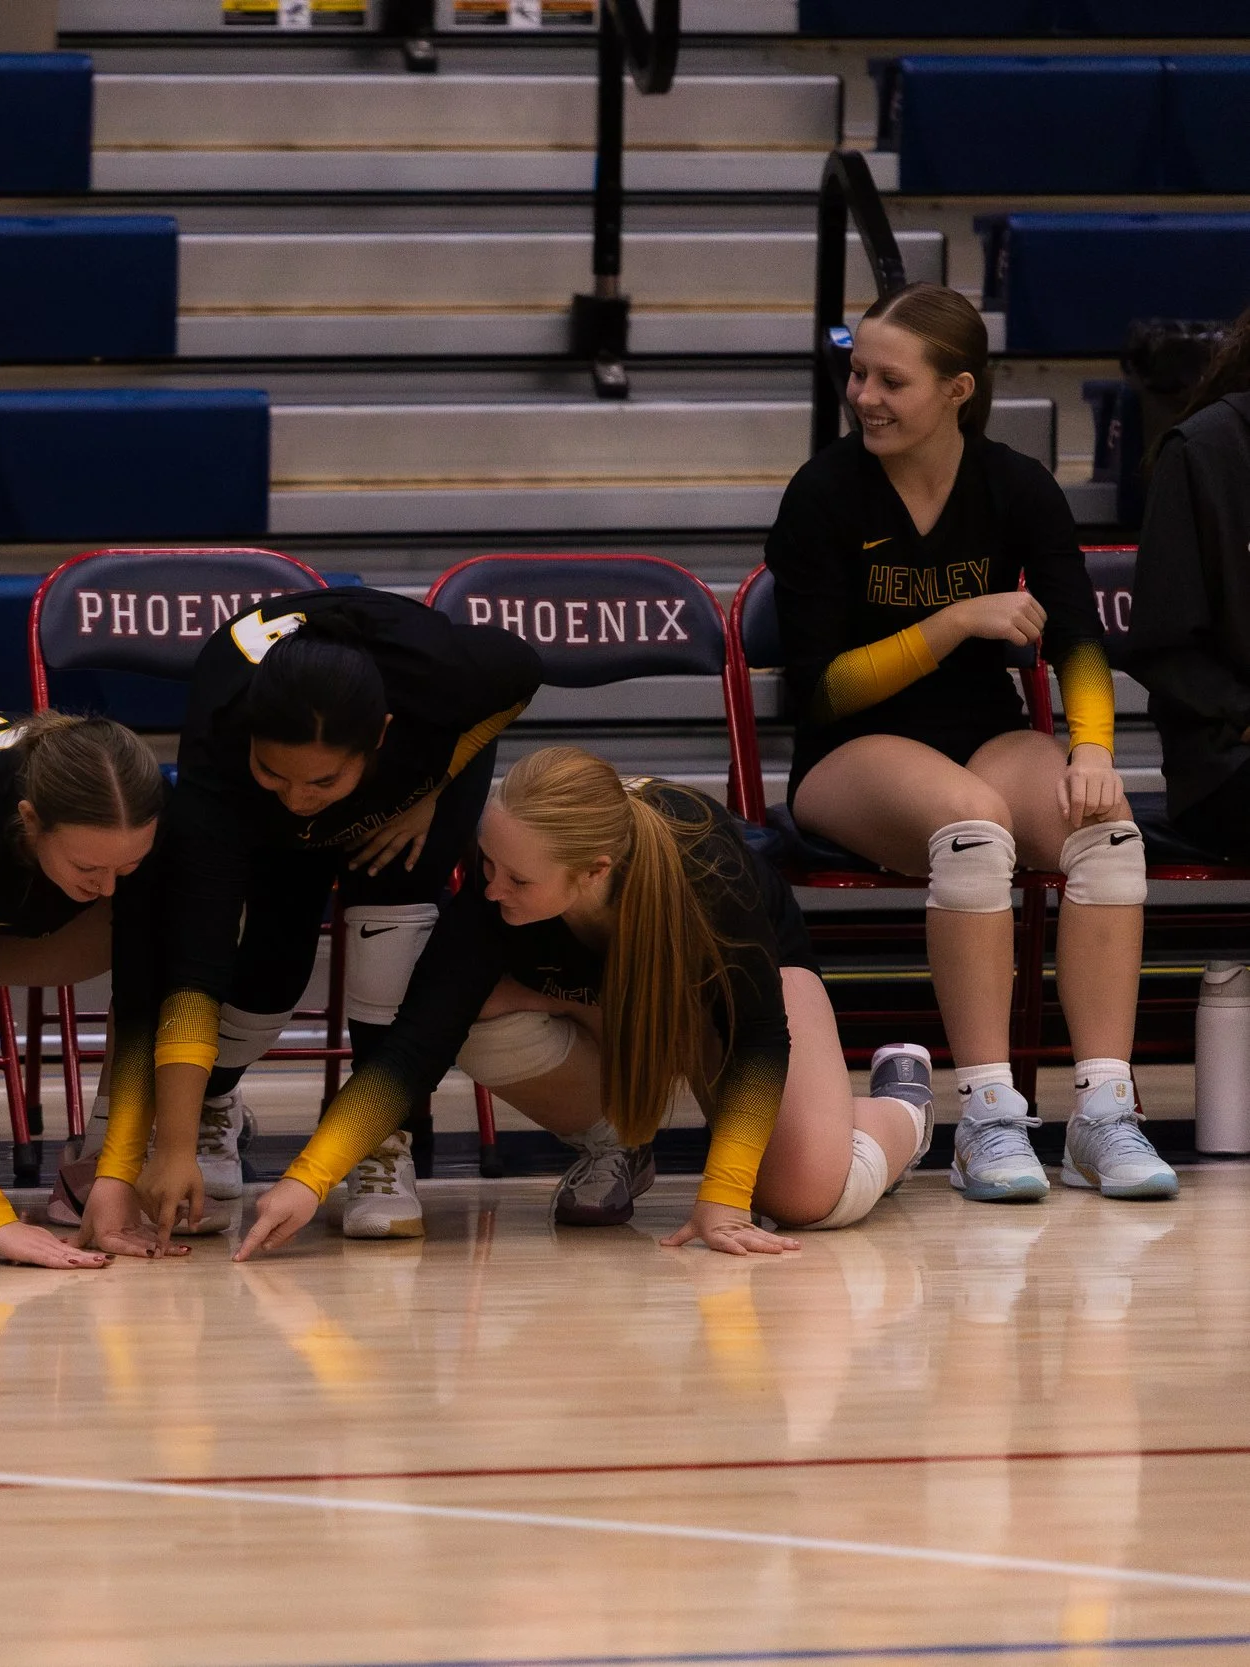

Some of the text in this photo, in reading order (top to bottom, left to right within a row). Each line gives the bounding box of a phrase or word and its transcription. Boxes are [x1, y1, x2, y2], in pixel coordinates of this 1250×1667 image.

[867, 557, 990, 607] HENLEY
[78, 591, 282, 636] PHOEN
[467, 597, 688, 644] PHOENIX
